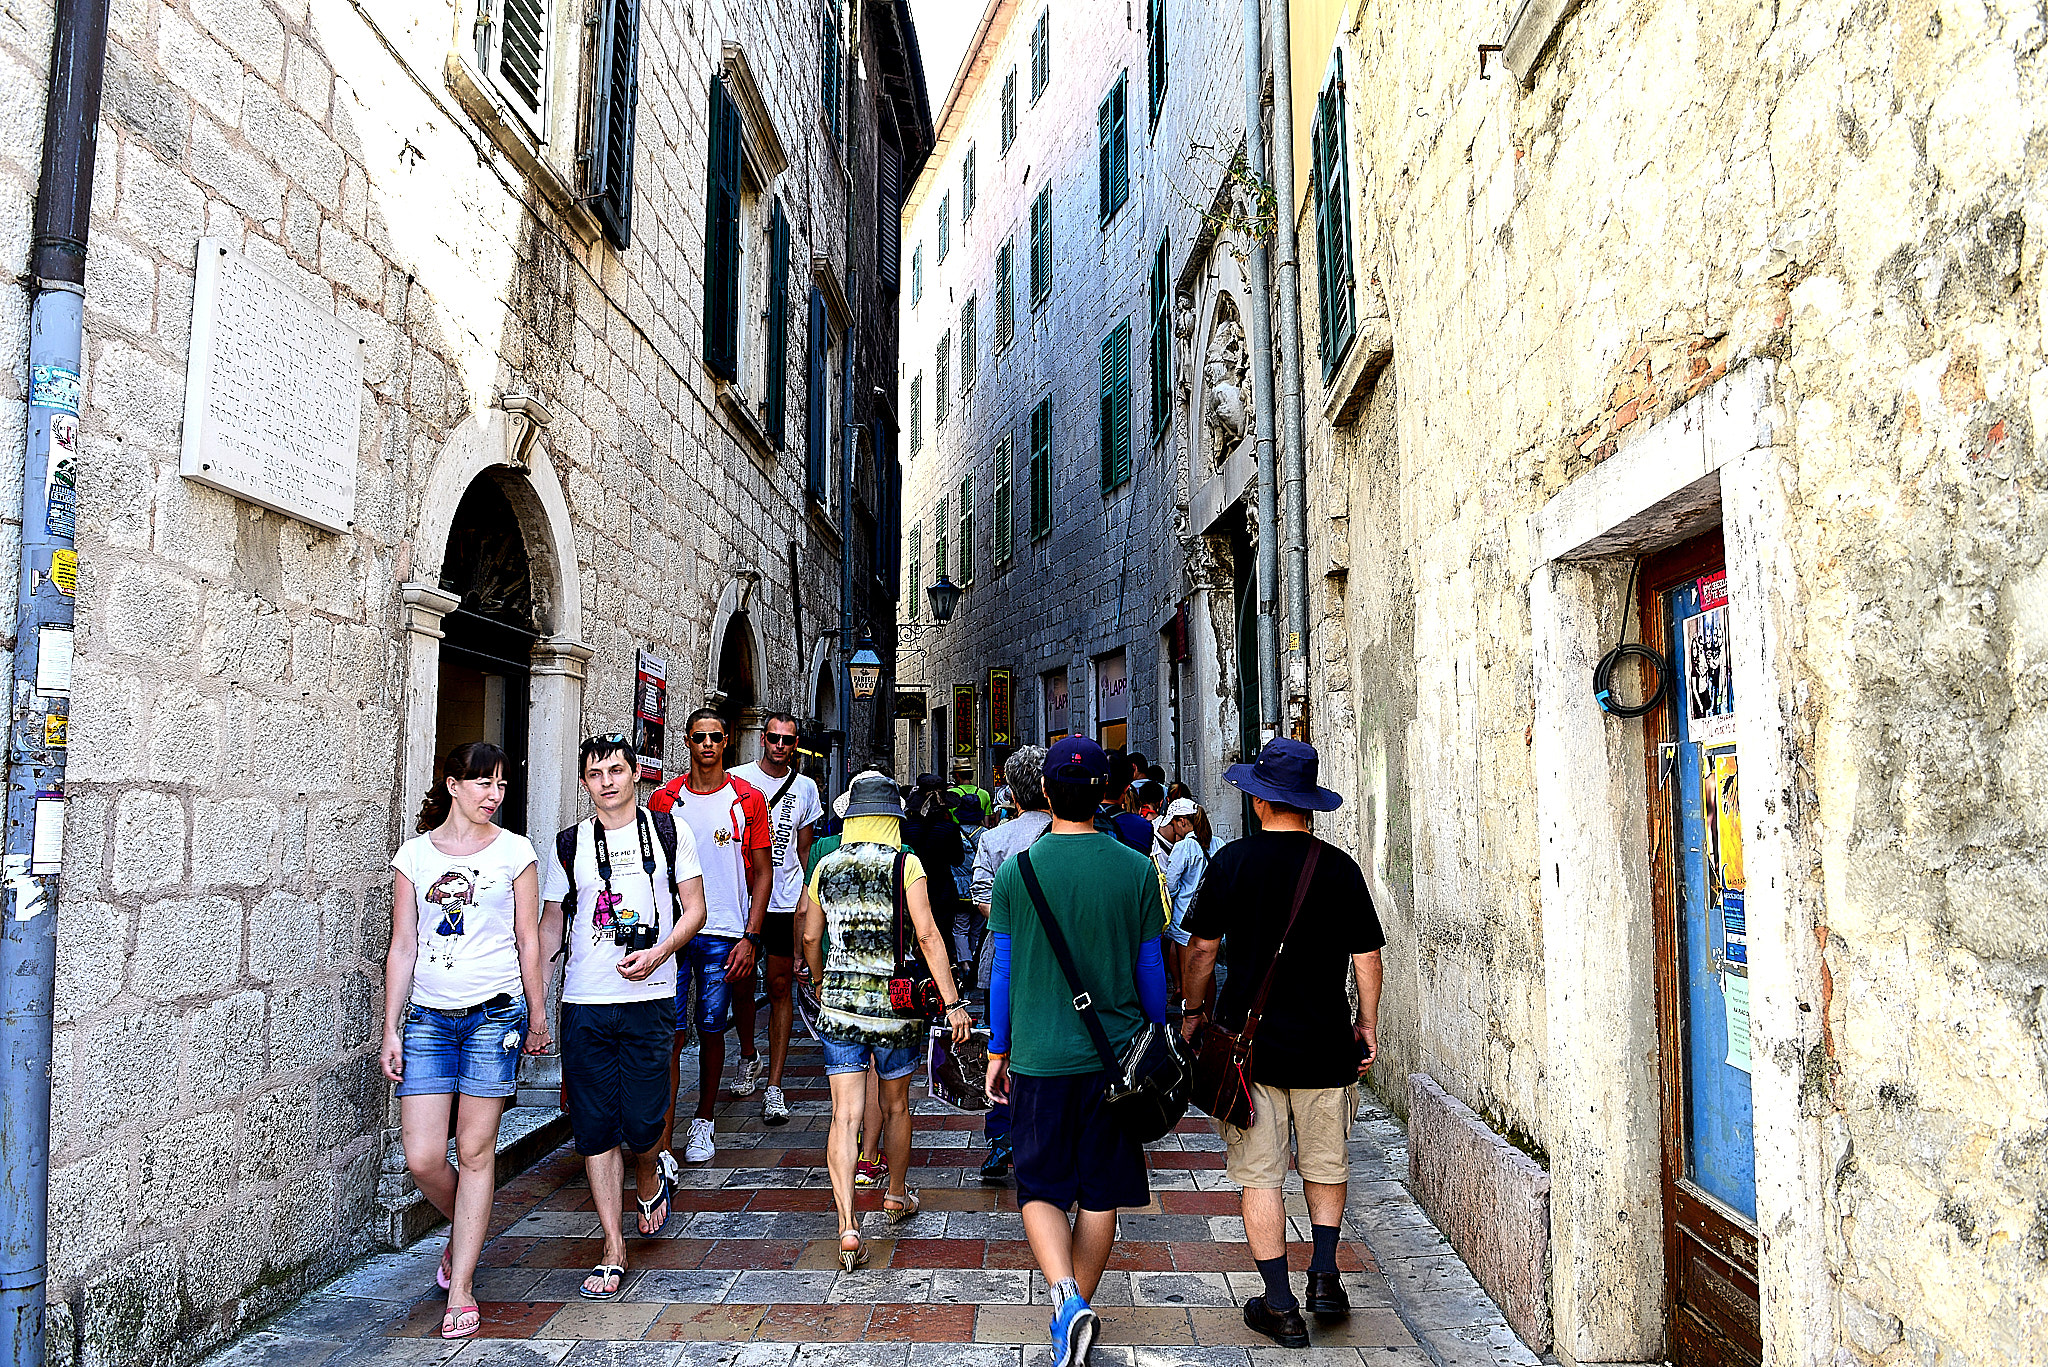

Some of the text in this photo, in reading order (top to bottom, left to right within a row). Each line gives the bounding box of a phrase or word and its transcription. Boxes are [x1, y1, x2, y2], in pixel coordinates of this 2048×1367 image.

[279, 306, 300, 332] BOKE
[993, 679, 1001, 730] CHINESE
[772, 823, 793, 867] DOBROTA
